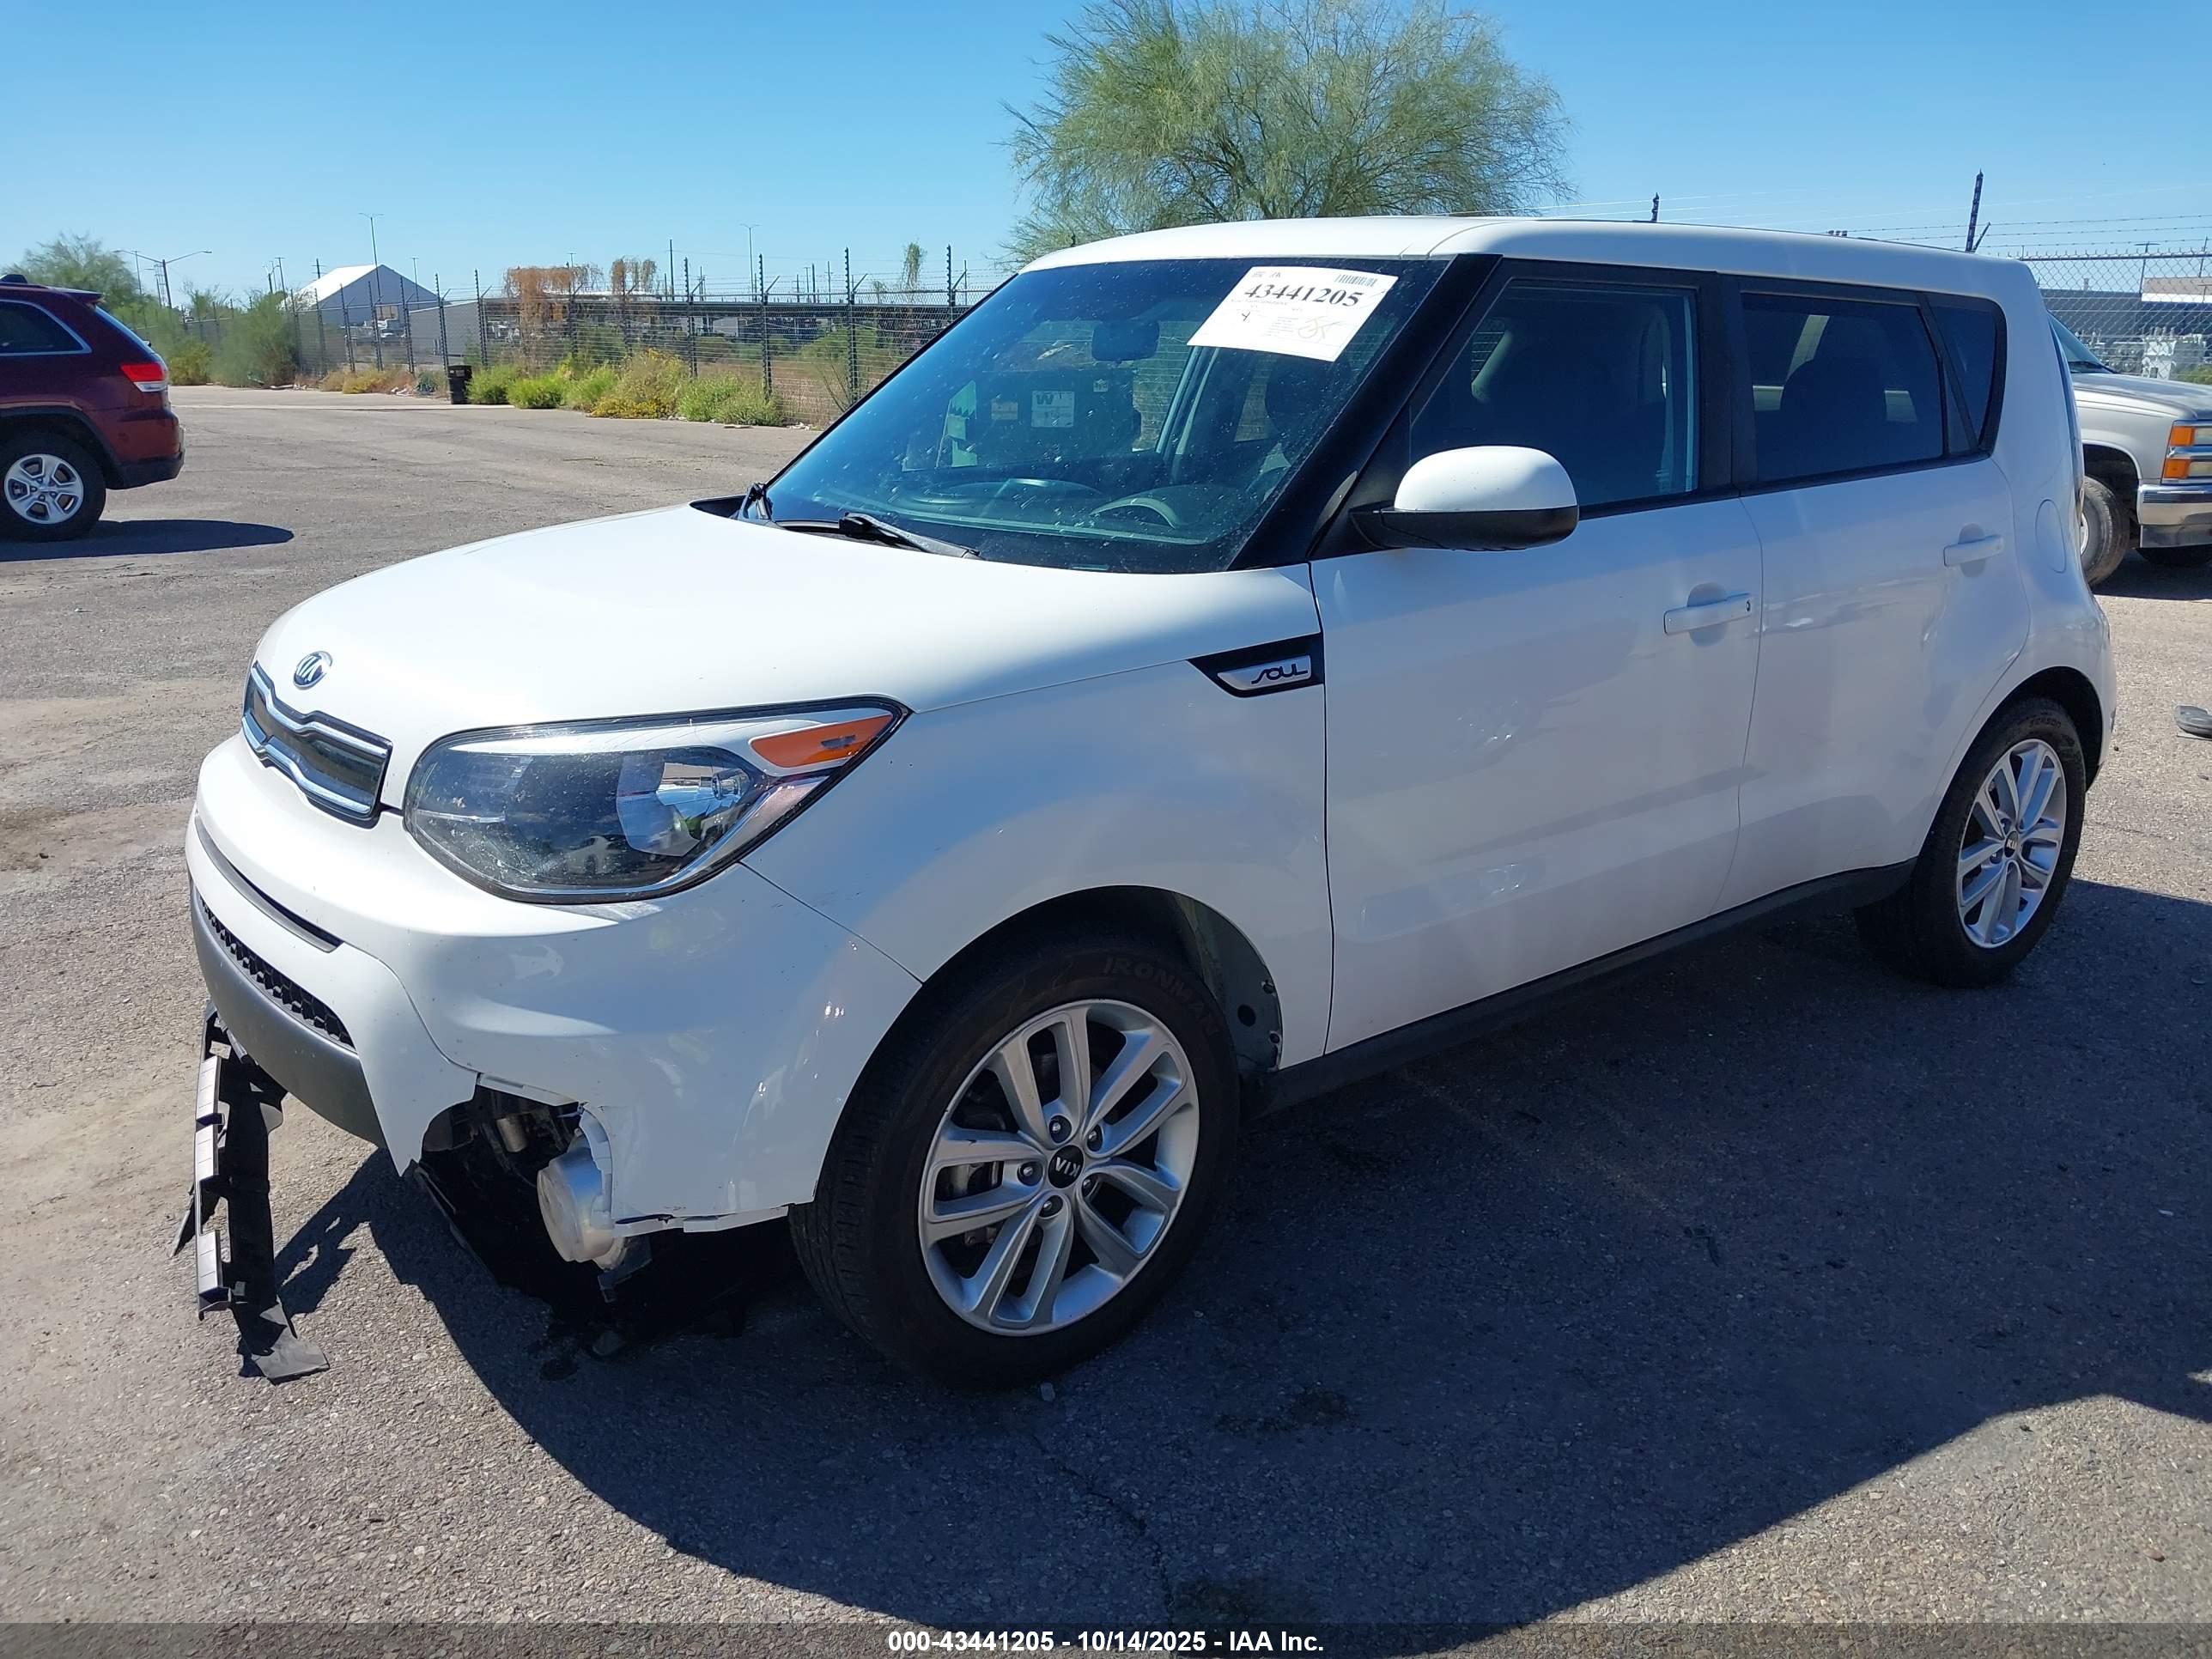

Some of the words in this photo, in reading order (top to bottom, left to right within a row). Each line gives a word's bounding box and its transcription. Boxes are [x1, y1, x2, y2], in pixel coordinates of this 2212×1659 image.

[1244, 283, 1365, 307] 43441205
[1251, 663, 1309, 684] SOUL
[1055, 1157, 1081, 1177] KIA
